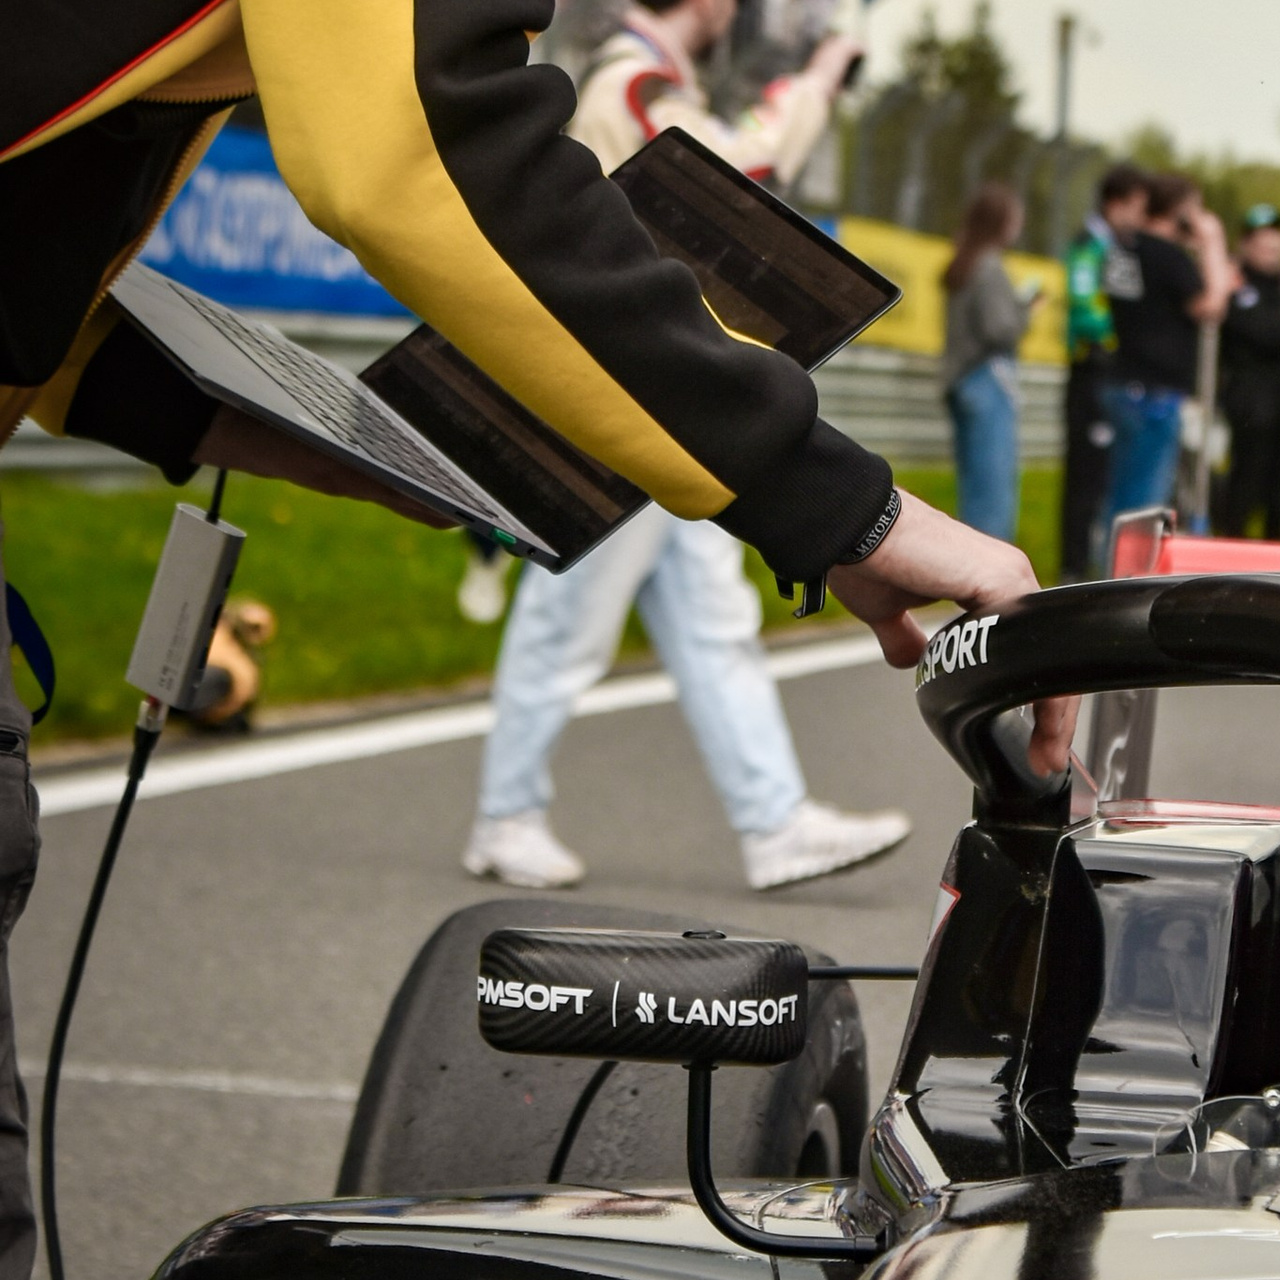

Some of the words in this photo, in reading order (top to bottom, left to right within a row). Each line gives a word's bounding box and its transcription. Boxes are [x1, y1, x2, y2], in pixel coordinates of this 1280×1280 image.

[856, 515, 891, 555] MAYOR
[923, 614, 1000, 683] SPORT
[477, 976, 594, 1015] PMSOFT
[667, 994, 798, 1027] LANSOFT
